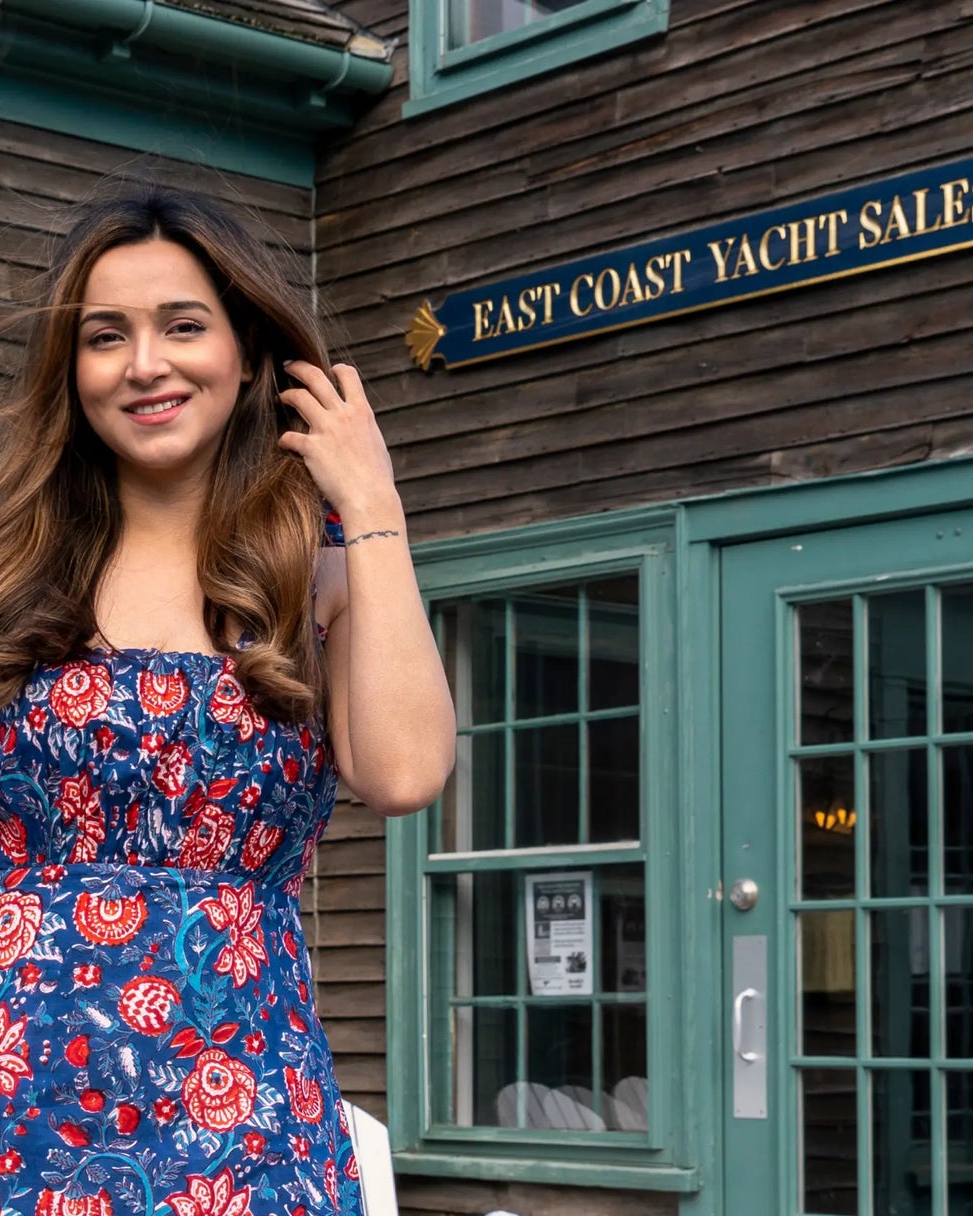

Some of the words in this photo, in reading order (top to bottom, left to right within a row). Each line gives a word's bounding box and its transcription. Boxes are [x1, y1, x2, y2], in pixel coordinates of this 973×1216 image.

[472, 282, 561, 342] EAST
[569, 249, 691, 316] COAST
[707, 209, 847, 283] YACHT
[858, 178, 973, 250] SALE
